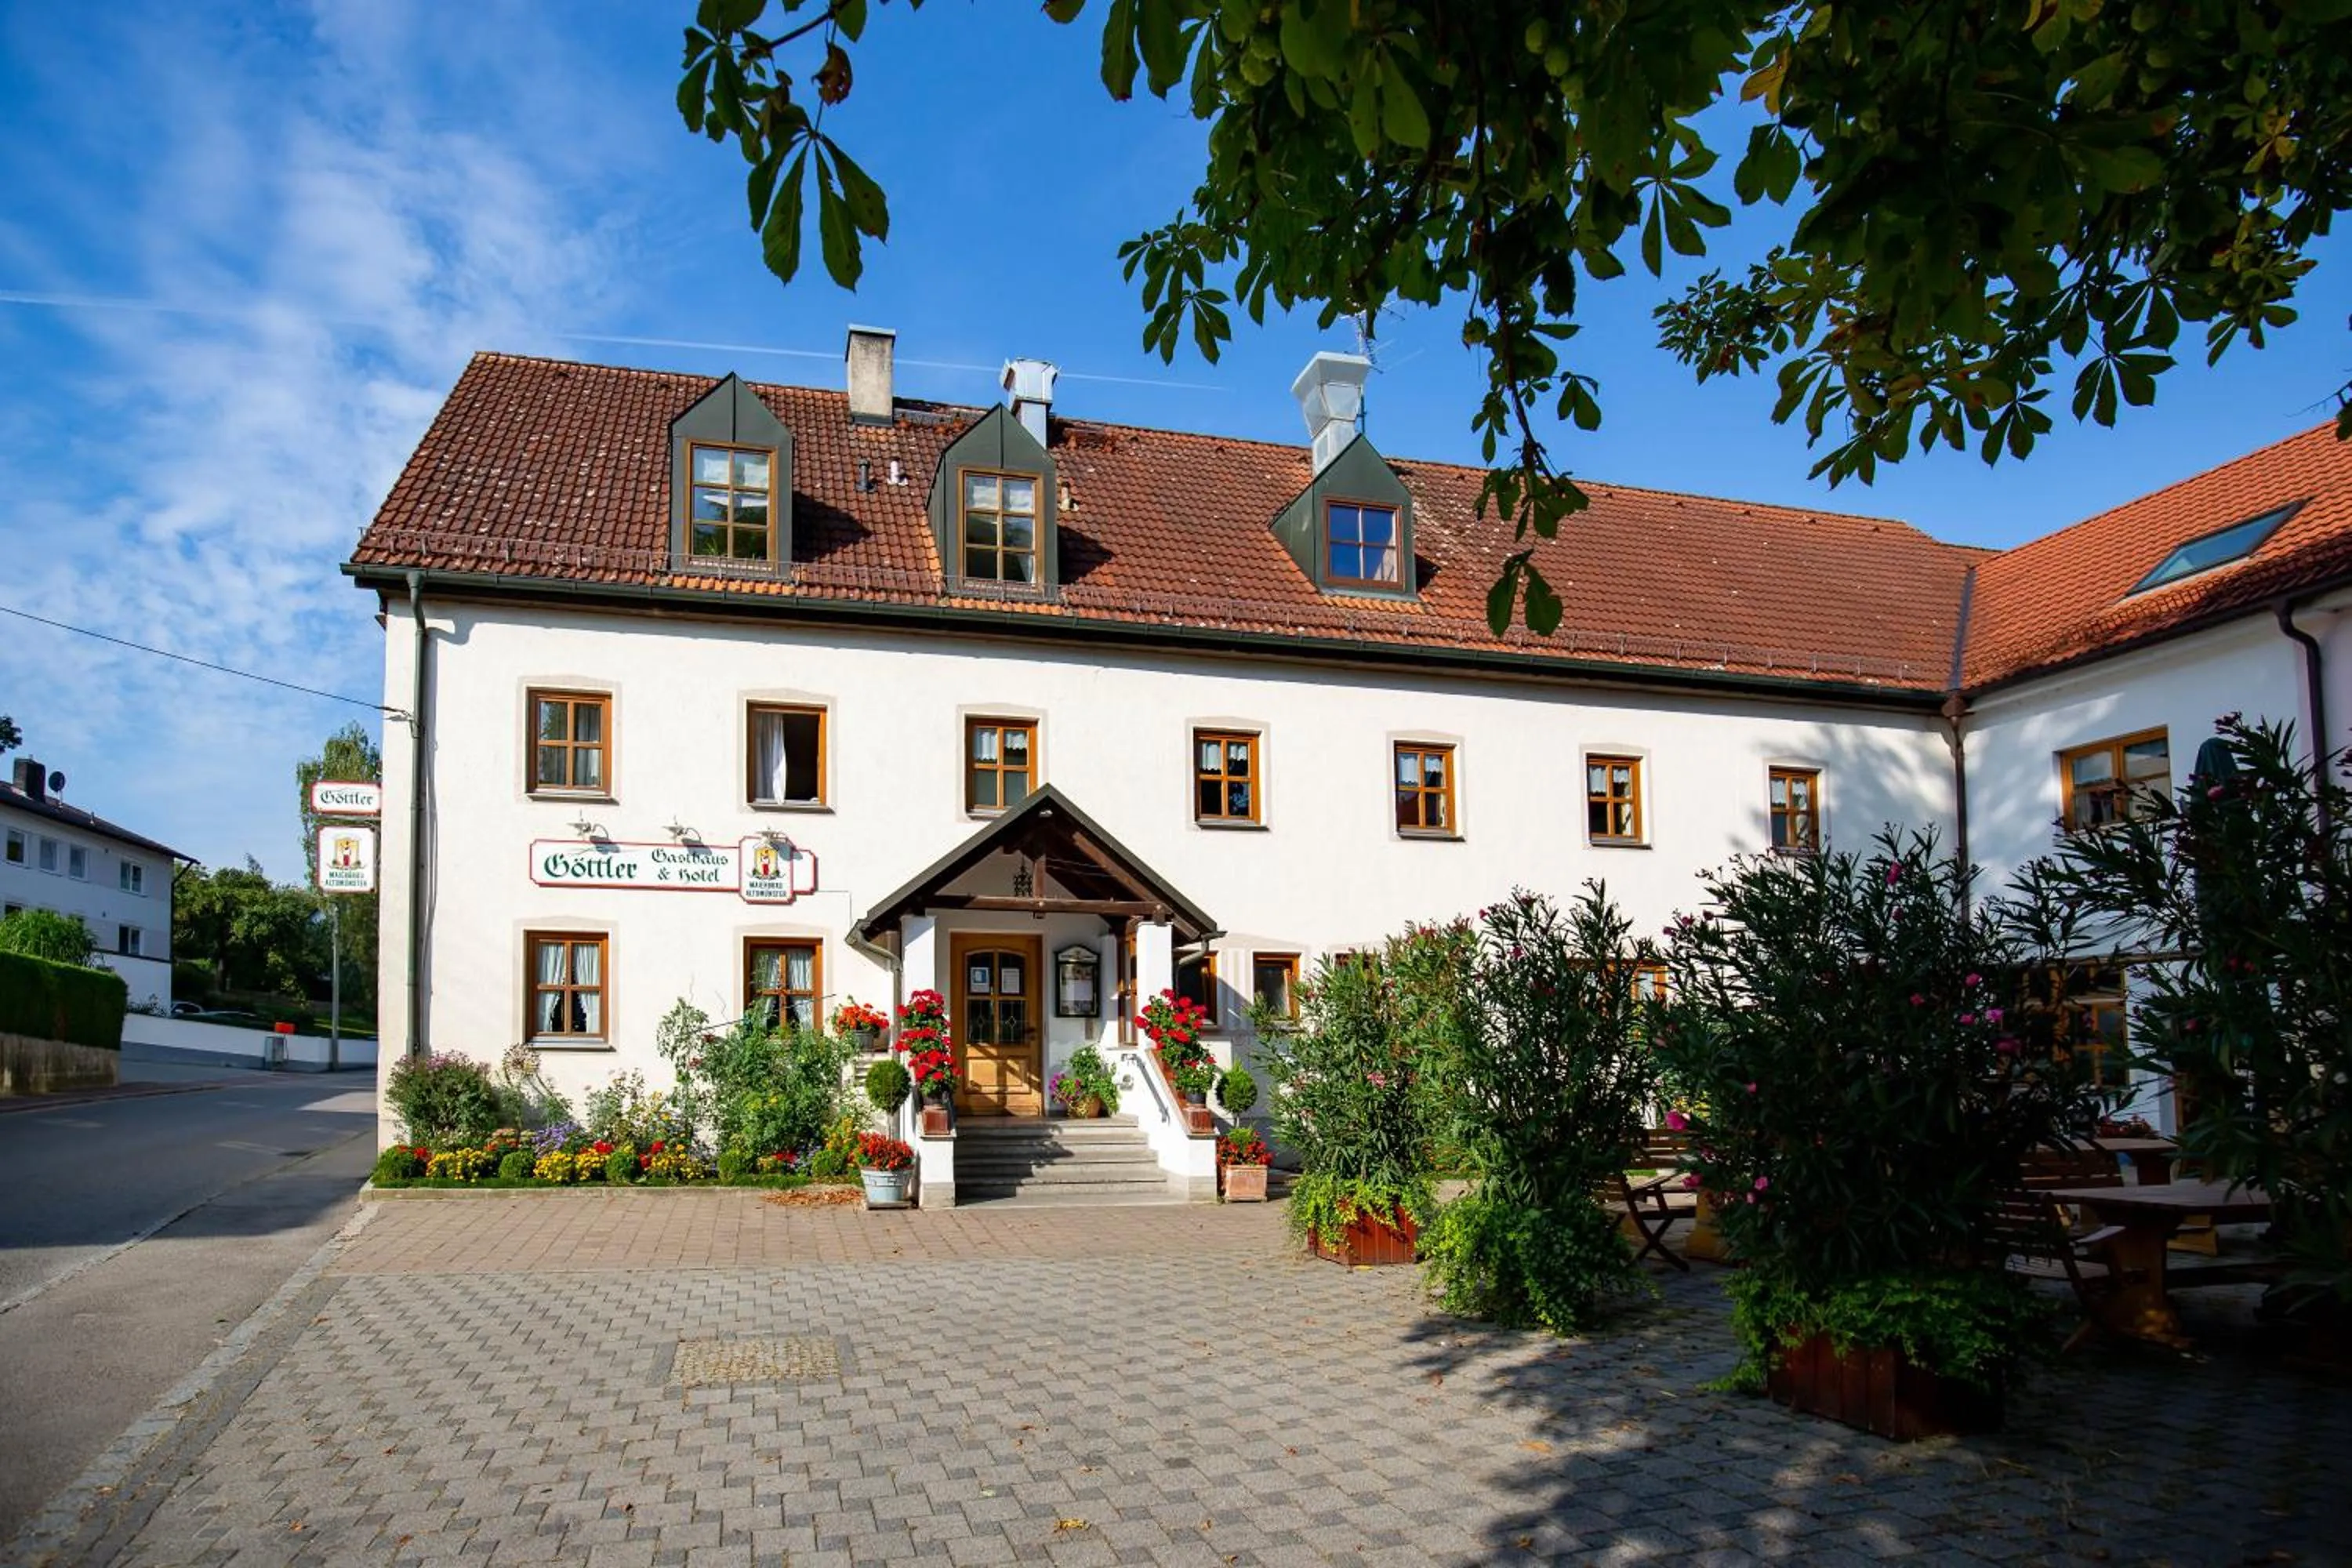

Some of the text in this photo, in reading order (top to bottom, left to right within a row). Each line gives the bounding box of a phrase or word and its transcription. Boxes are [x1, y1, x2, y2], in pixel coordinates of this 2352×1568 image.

[321, 790, 373, 805] Göttler
[651, 848, 728, 866] Gasthaus
[544, 853, 637, 879] Göttler
[657, 867, 720, 884] & Hotel
